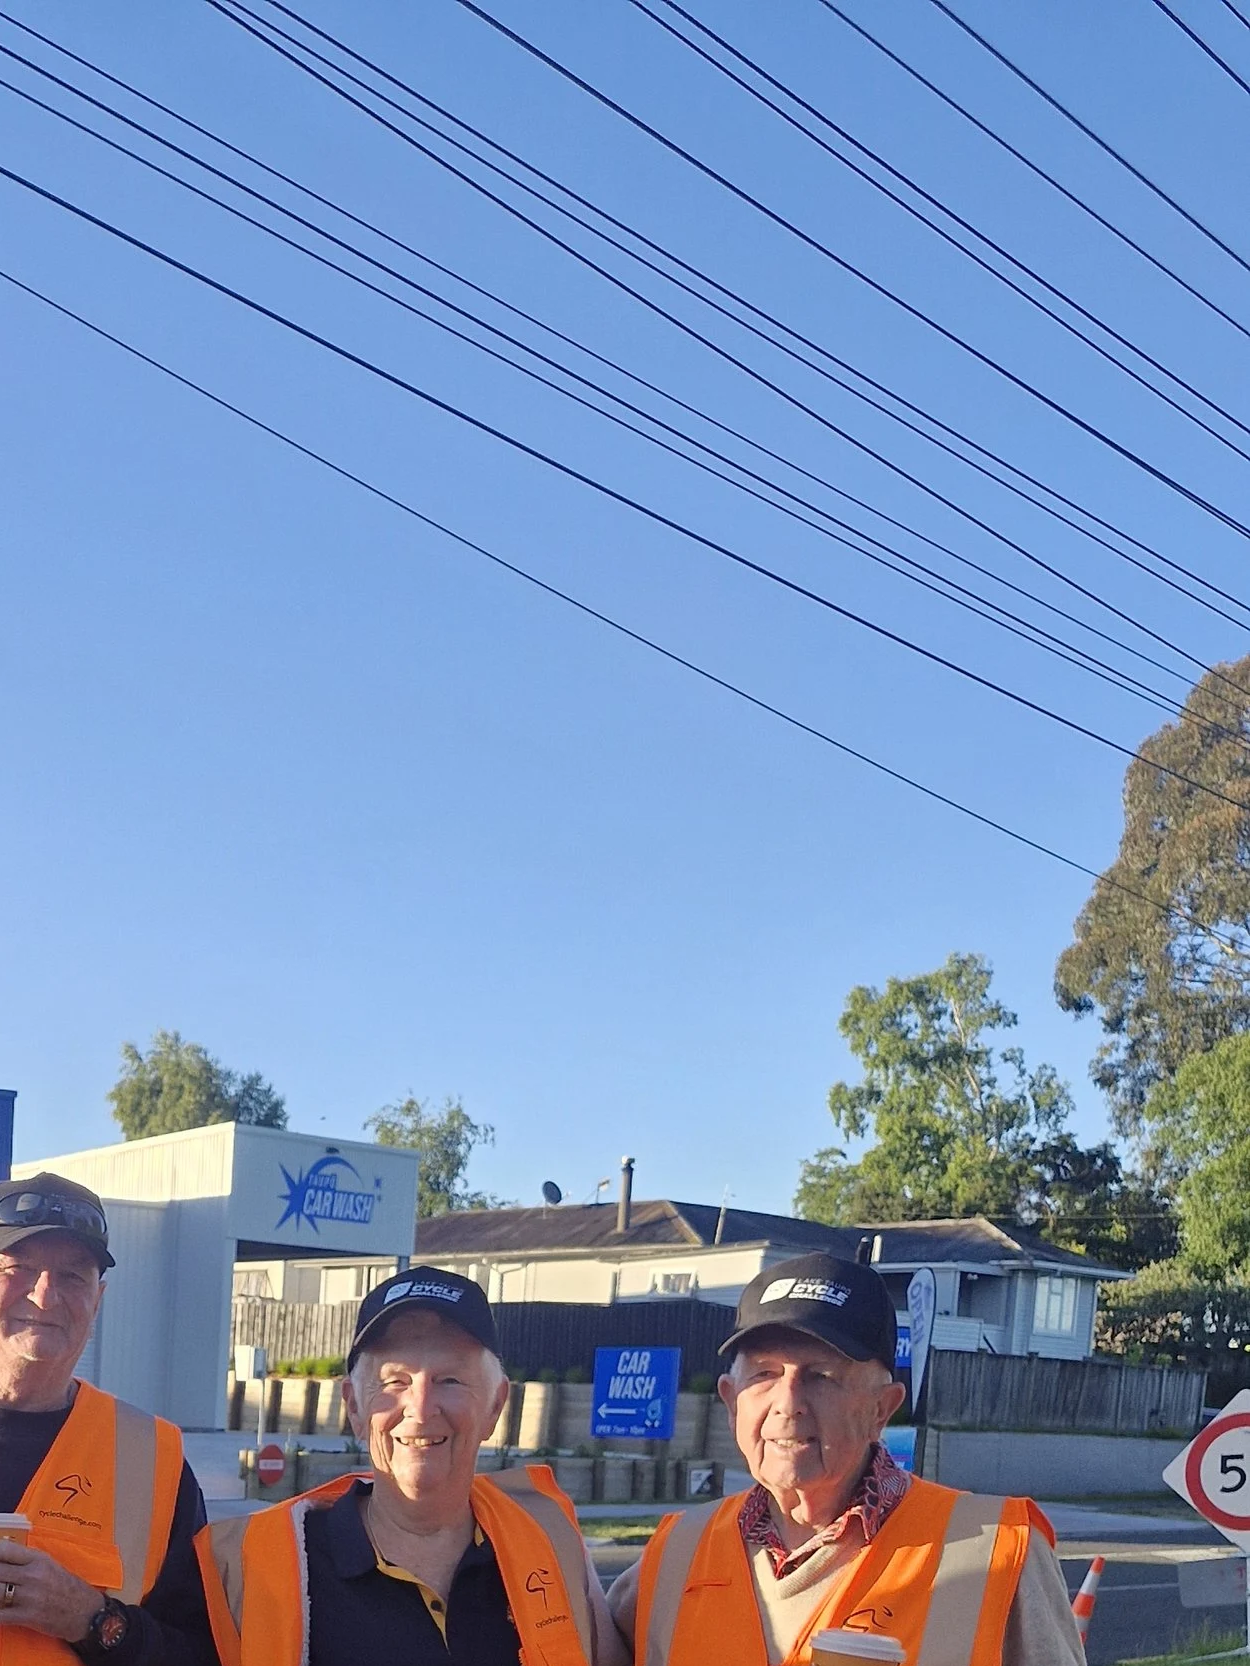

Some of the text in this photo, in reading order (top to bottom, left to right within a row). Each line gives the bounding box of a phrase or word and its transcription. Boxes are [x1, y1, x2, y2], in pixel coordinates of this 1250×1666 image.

[411, 1285, 461, 1300] CYCLE
[792, 1283, 849, 1302] CYCLE
[617, 1351, 651, 1374] CAR
[608, 1375, 656, 1399] WASH
[1220, 1454, 1247, 1493] 5
